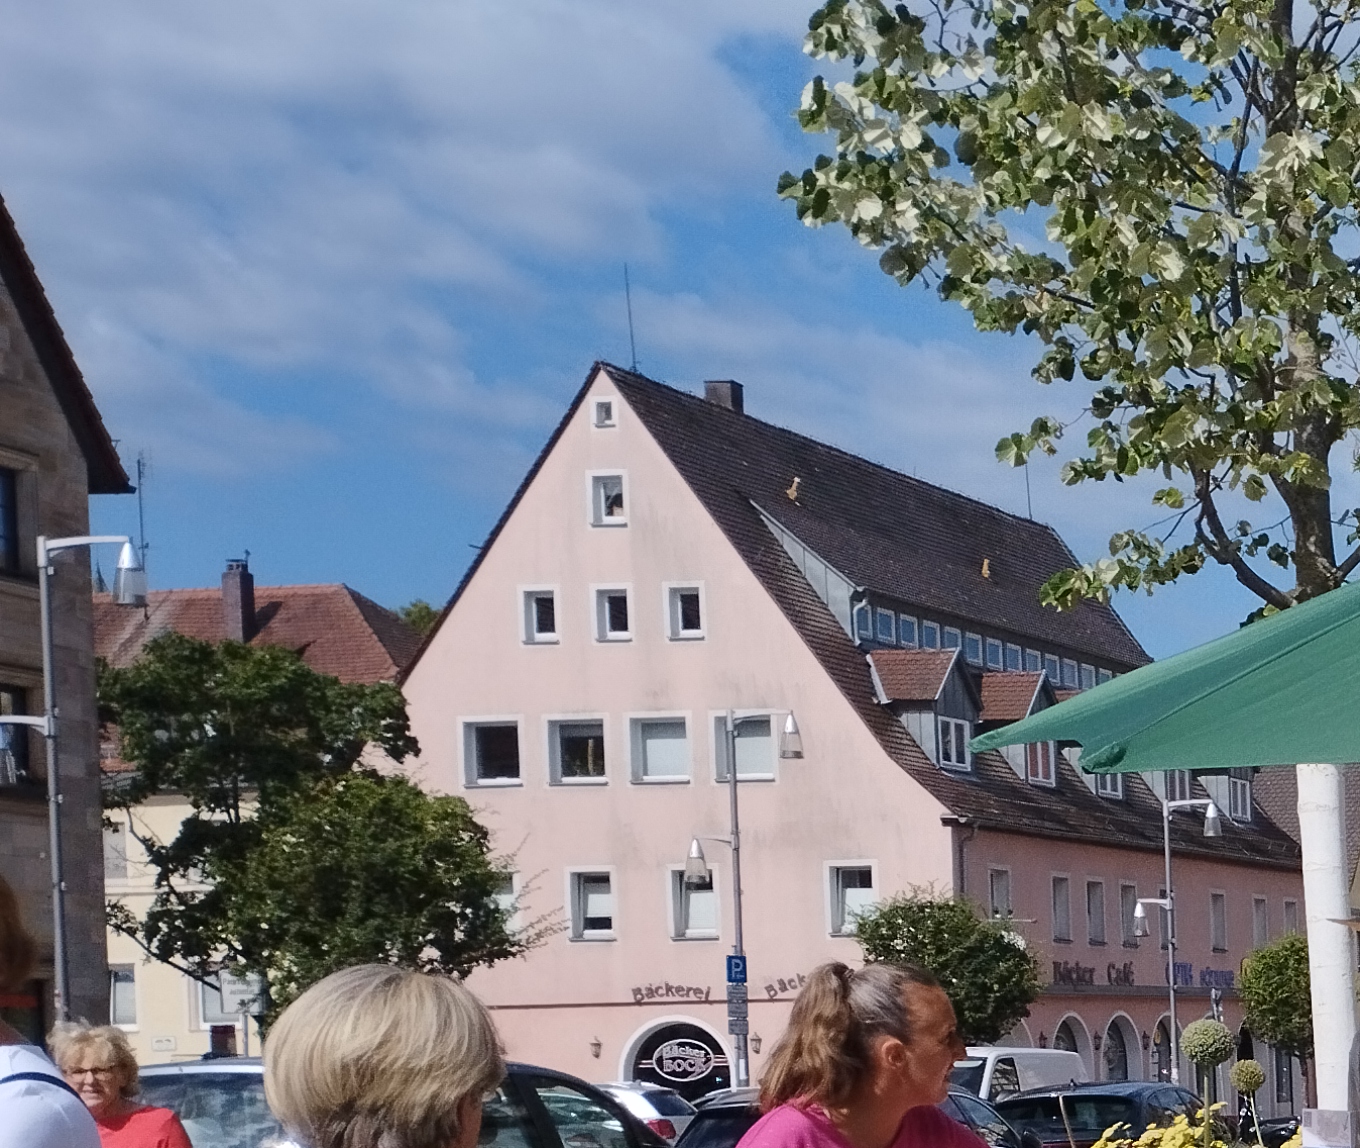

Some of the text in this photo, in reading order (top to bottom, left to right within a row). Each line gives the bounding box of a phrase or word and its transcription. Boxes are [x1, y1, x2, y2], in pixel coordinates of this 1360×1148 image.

[731, 958, 743, 978] P
[631, 982, 711, 1003] Bäckerei
[663, 1059, 706, 1072] BOCK
